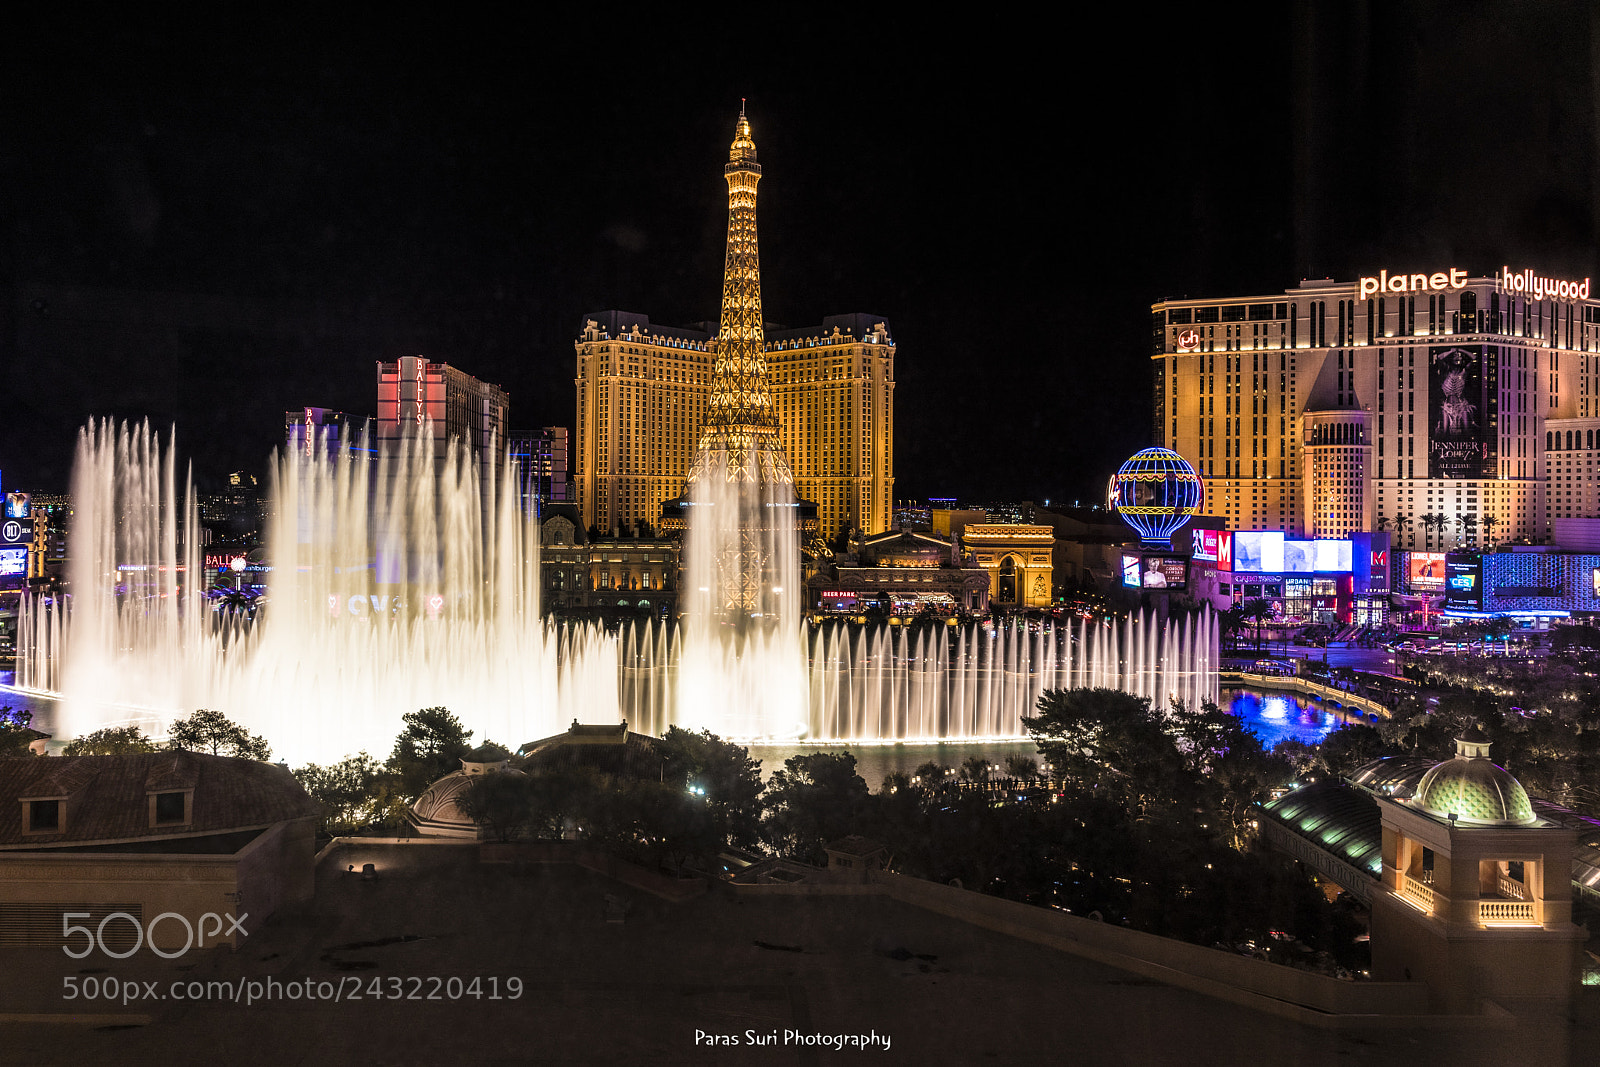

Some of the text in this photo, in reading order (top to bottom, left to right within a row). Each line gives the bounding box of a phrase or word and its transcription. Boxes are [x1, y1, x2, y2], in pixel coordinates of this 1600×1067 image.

[1360, 265, 1590, 301] planet hollywood
[1431, 440, 1479, 453] JENNIFER
[6, 525, 18, 537] BLT
[1218, 535, 1231, 562] M
[1452, 578, 1470, 586] CES
